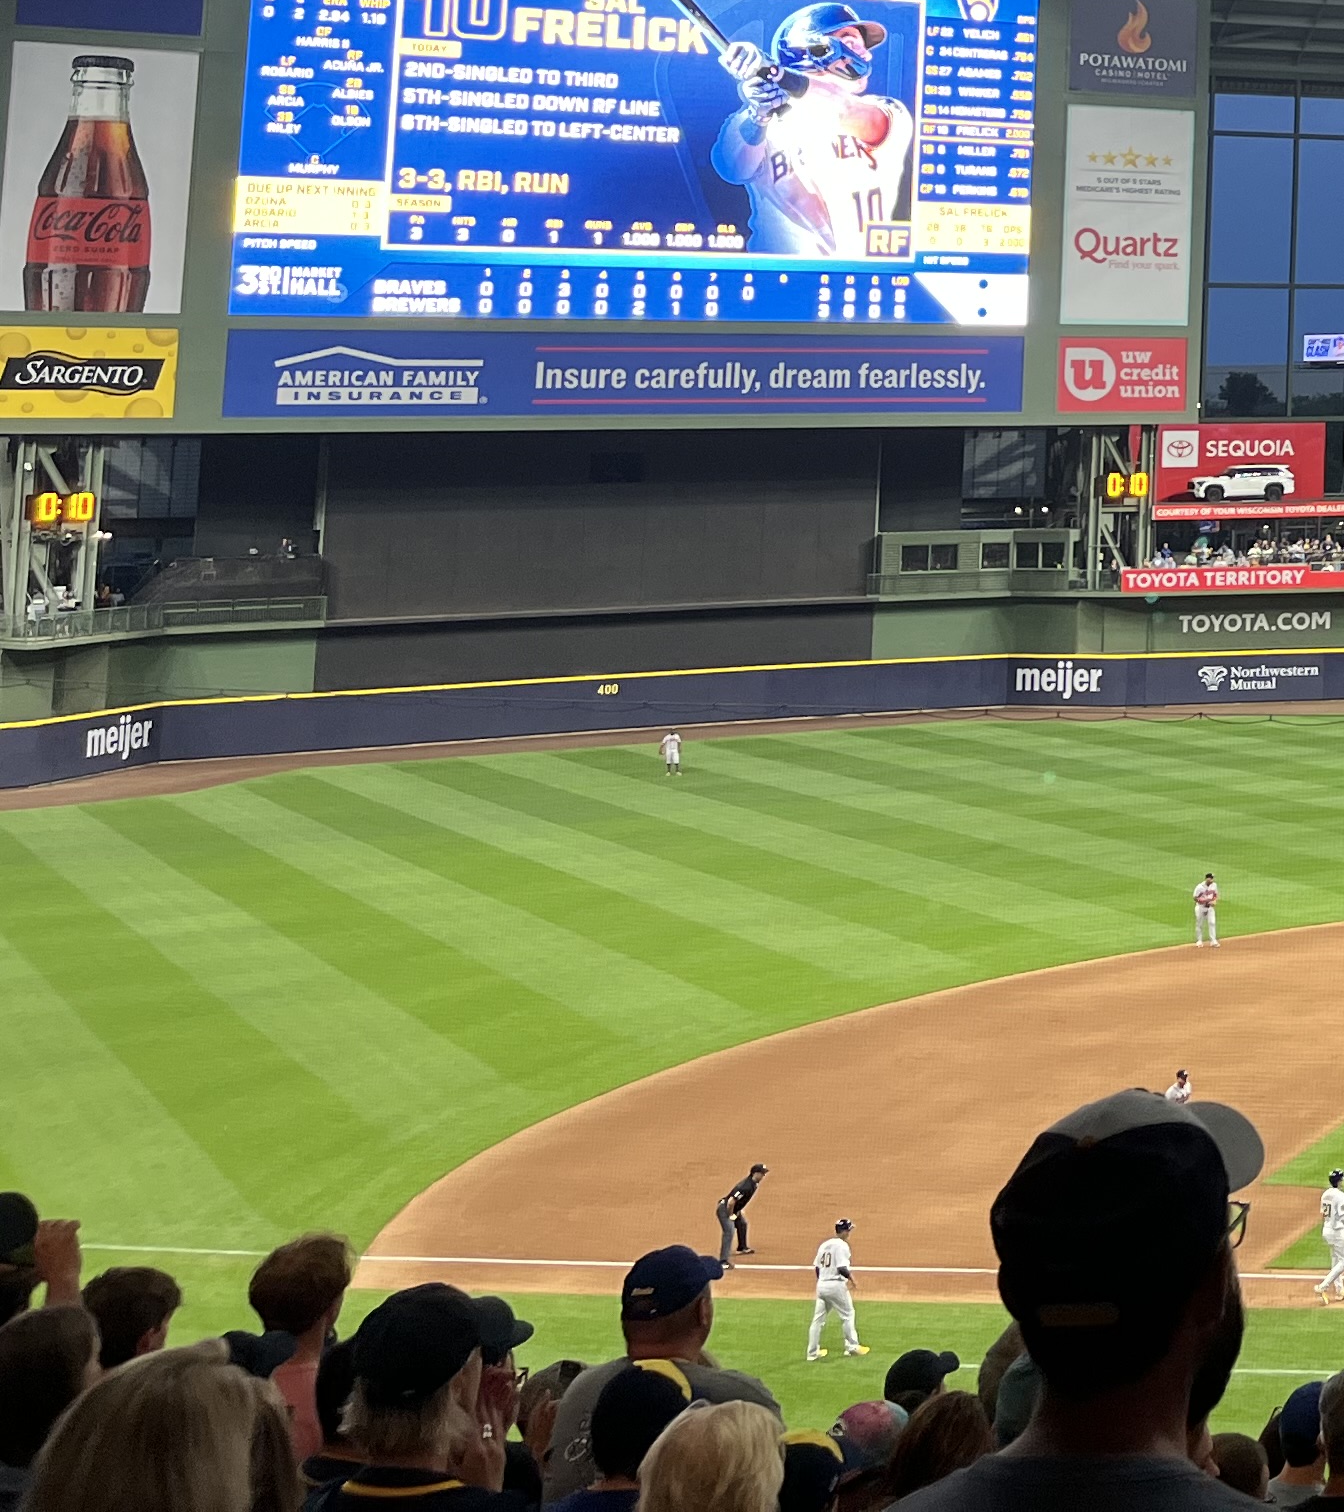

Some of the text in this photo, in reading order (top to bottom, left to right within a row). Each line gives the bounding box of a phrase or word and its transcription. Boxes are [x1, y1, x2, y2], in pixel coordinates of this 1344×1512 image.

[513, 7, 708, 54] FRELICK
[412, 43, 447, 53] TODAY
[1079, 52, 1187, 73] POTAWATOMI
[404, 61, 619, 89] 2ND-SINGLED TO THIRD
[1095, 69, 1168, 80] CASINO HOTEL
[402, 88, 661, 117] 5TH-SINGLED DOWN RF LINE
[531, 120, 556, 137] TO
[559, 122, 680, 144] LEFT-CENTER
[297, 185, 329, 195] NEXT
[398, 168, 569, 195] 3-3, RBI, RUN
[1103, 177, 1161, 186] OUT STARS
[34, 200, 144, 243] Coca-Cola
[869, 228, 909, 255] RF
[1074, 227, 1178, 264] Quartz
[1109, 260, 1180, 271] Find your spark.
[291, 277, 341, 296] HALL
[373, 279, 446, 296] BRAVES
[372, 297, 461, 314] BREWERS
[1121, 351, 1152, 364] uw
[15, 359, 145, 386] SARGENTO
[278, 370, 480, 387] AMERICAN FAMILY
[534, 361, 986, 395] Insure carefully, dream fearlessly.
[1120, 365, 1179, 380] credit
[293, 391, 464, 401] INSURANCE
[1120, 381, 1180, 398] union
[1206, 439, 1295, 457] SEQUOIA
[1107, 472, 1148, 497] 0:10
[35, 492, 95, 522] 0:10
[1156, 506, 1200, 517] COURTESY
[1200, 507, 1212, 516] OF
[1213, 506, 1236, 516] YOUR
[1237, 505, 1284, 515] WISCONSIN
[1285, 504, 1315, 514] TOYOTA
[1125, 569, 1305, 588] TOYOTA TERRITORY
[1179, 611, 1331, 633] TOYOTA.COM
[1016, 661, 1102, 699] meijer
[1229, 665, 1319, 679] Northwestern
[597, 683, 619, 695] 400
[1229, 677, 1277, 690] Mutual
[86, 715, 152, 760] meijer
